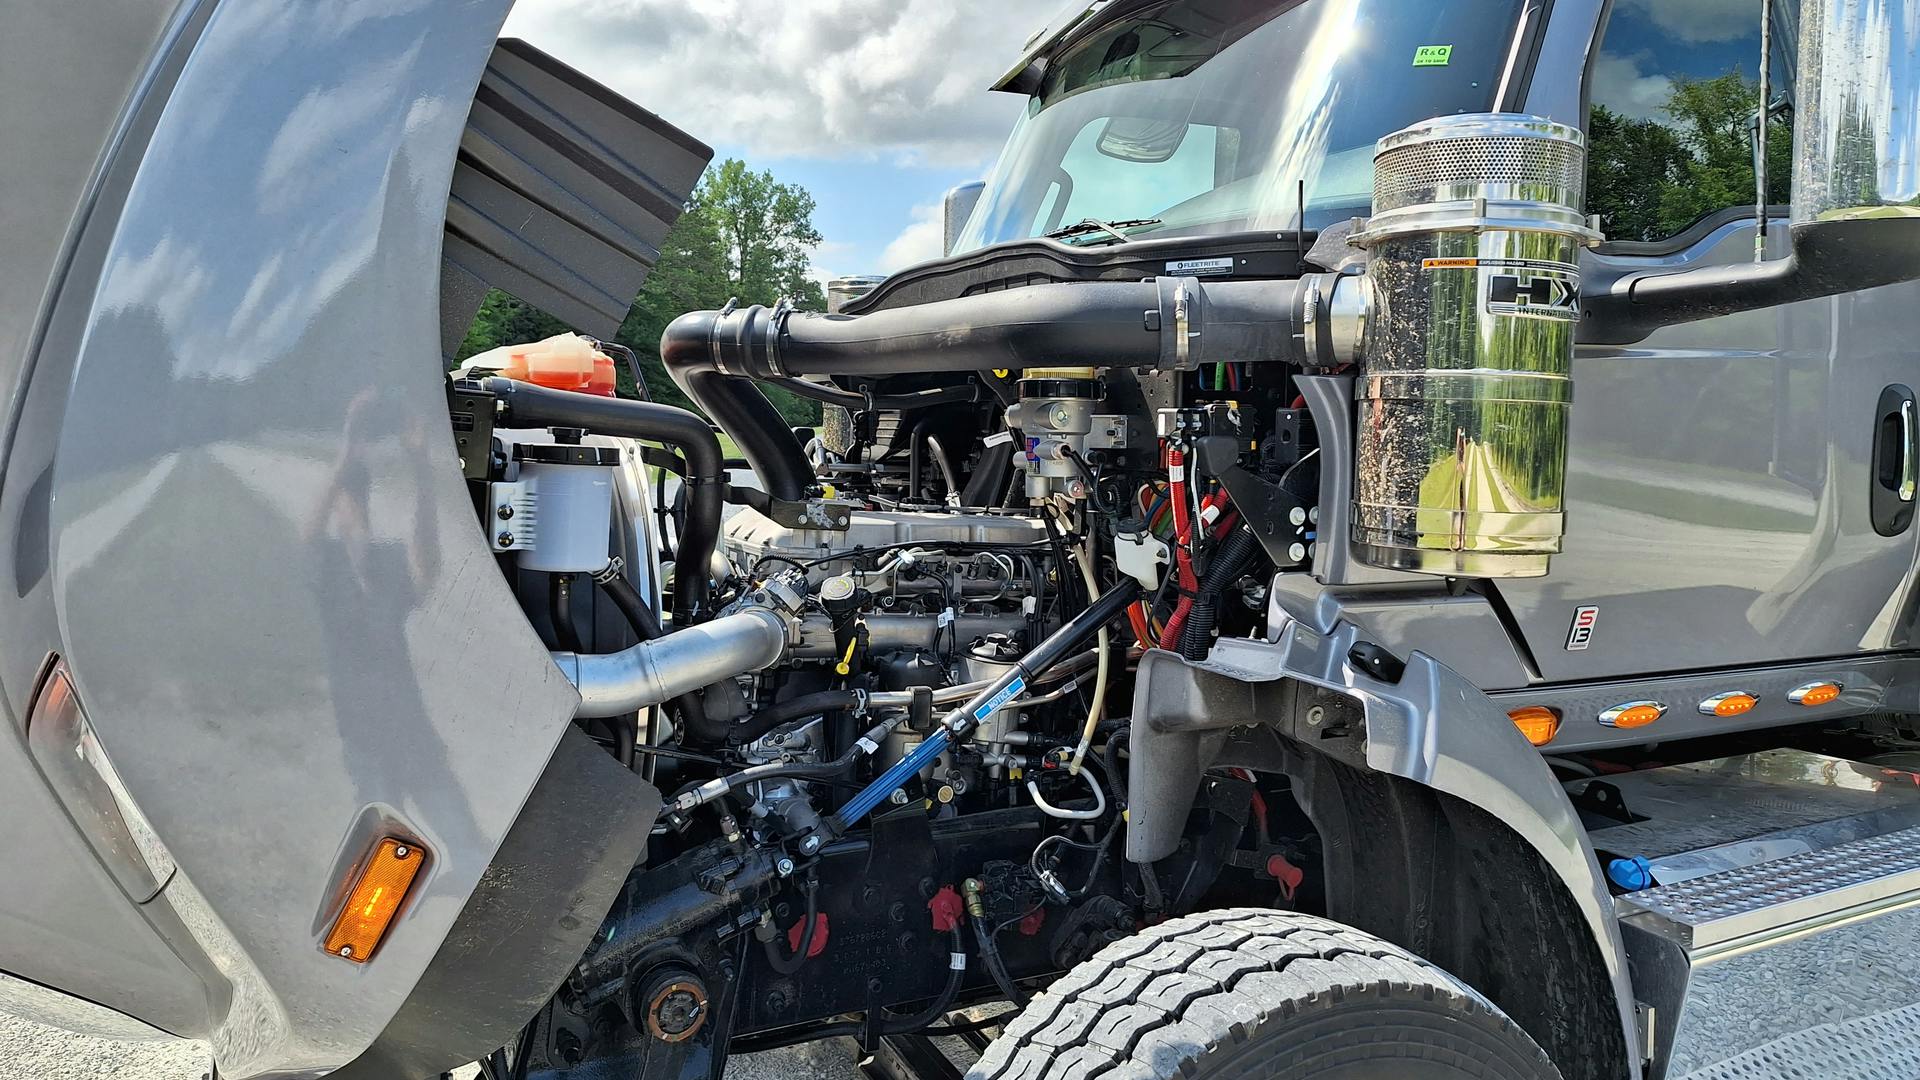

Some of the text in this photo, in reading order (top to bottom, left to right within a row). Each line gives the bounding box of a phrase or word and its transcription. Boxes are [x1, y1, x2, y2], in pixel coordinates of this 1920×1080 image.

[1183, 261, 1218, 269] FLEETRITE
[1490, 275, 1580, 310] HX
[1577, 610, 1596, 626] S
[1571, 627, 1591, 643] 13
[987, 688, 1012, 710] NOTICE
